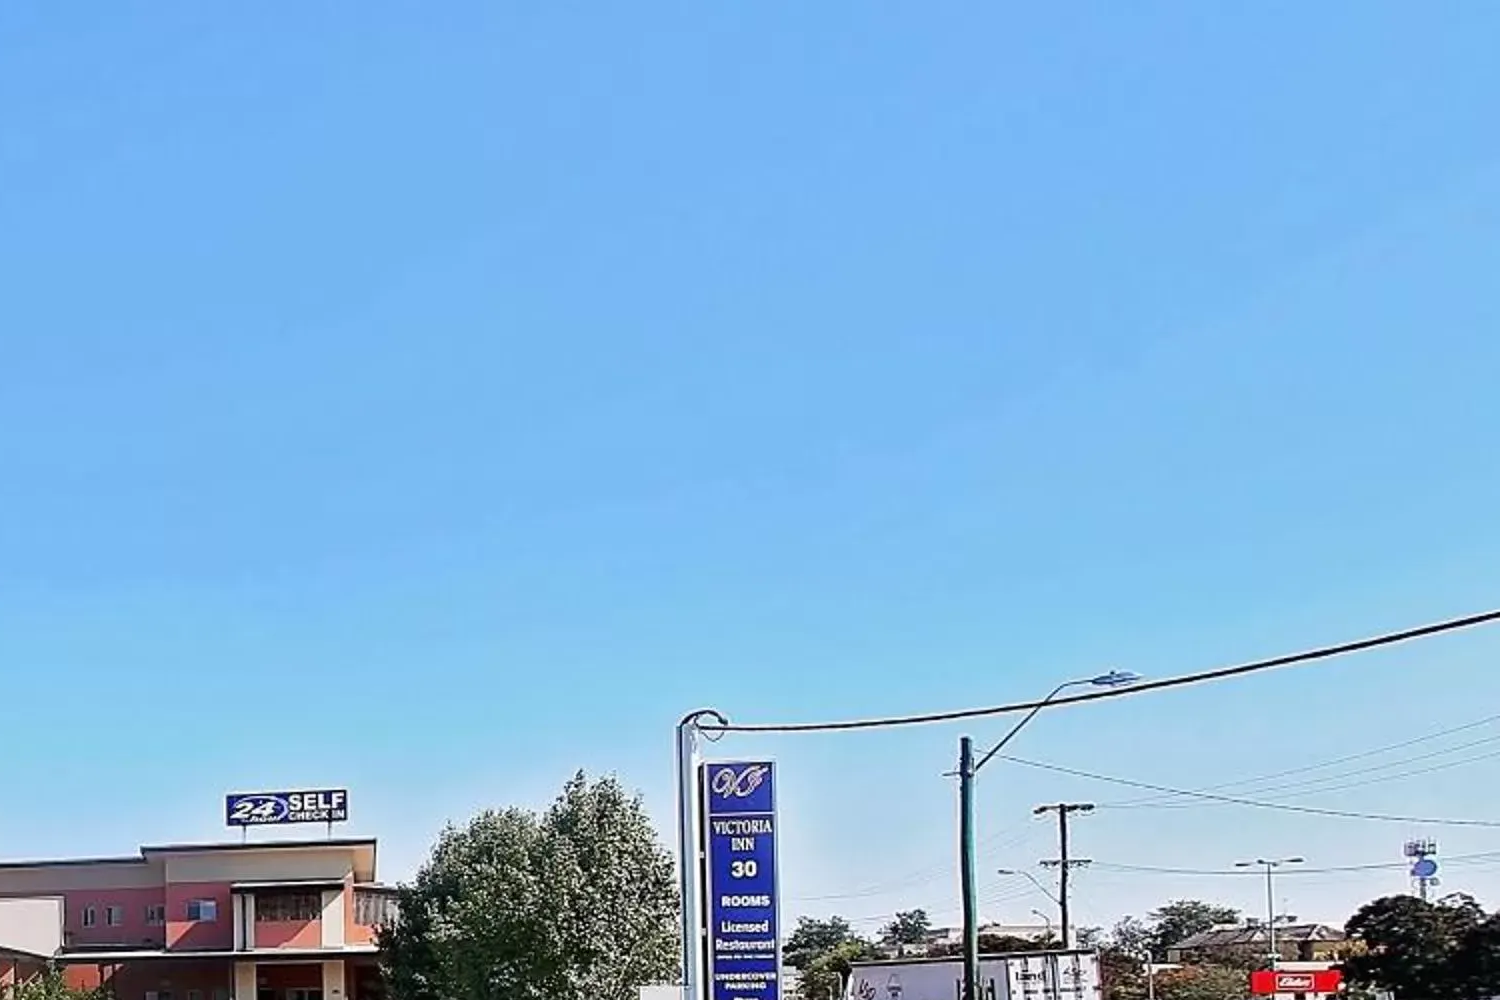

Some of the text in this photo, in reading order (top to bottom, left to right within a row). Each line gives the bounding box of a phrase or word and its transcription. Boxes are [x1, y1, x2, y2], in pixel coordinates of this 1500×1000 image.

[288, 793, 344, 810] SELF
[230, 801, 276, 818] 24
[288, 812, 329, 821] CHECK
[712, 820, 772, 834] VICTORIA
[731, 837, 755, 851] INN
[731, 860, 757, 878] 30
[721, 896, 770, 907] ROOMS
[721, 920, 769, 933] Licensed
[715, 938, 775, 951] Restaurant
[724, 982, 767, 990] PARKING
